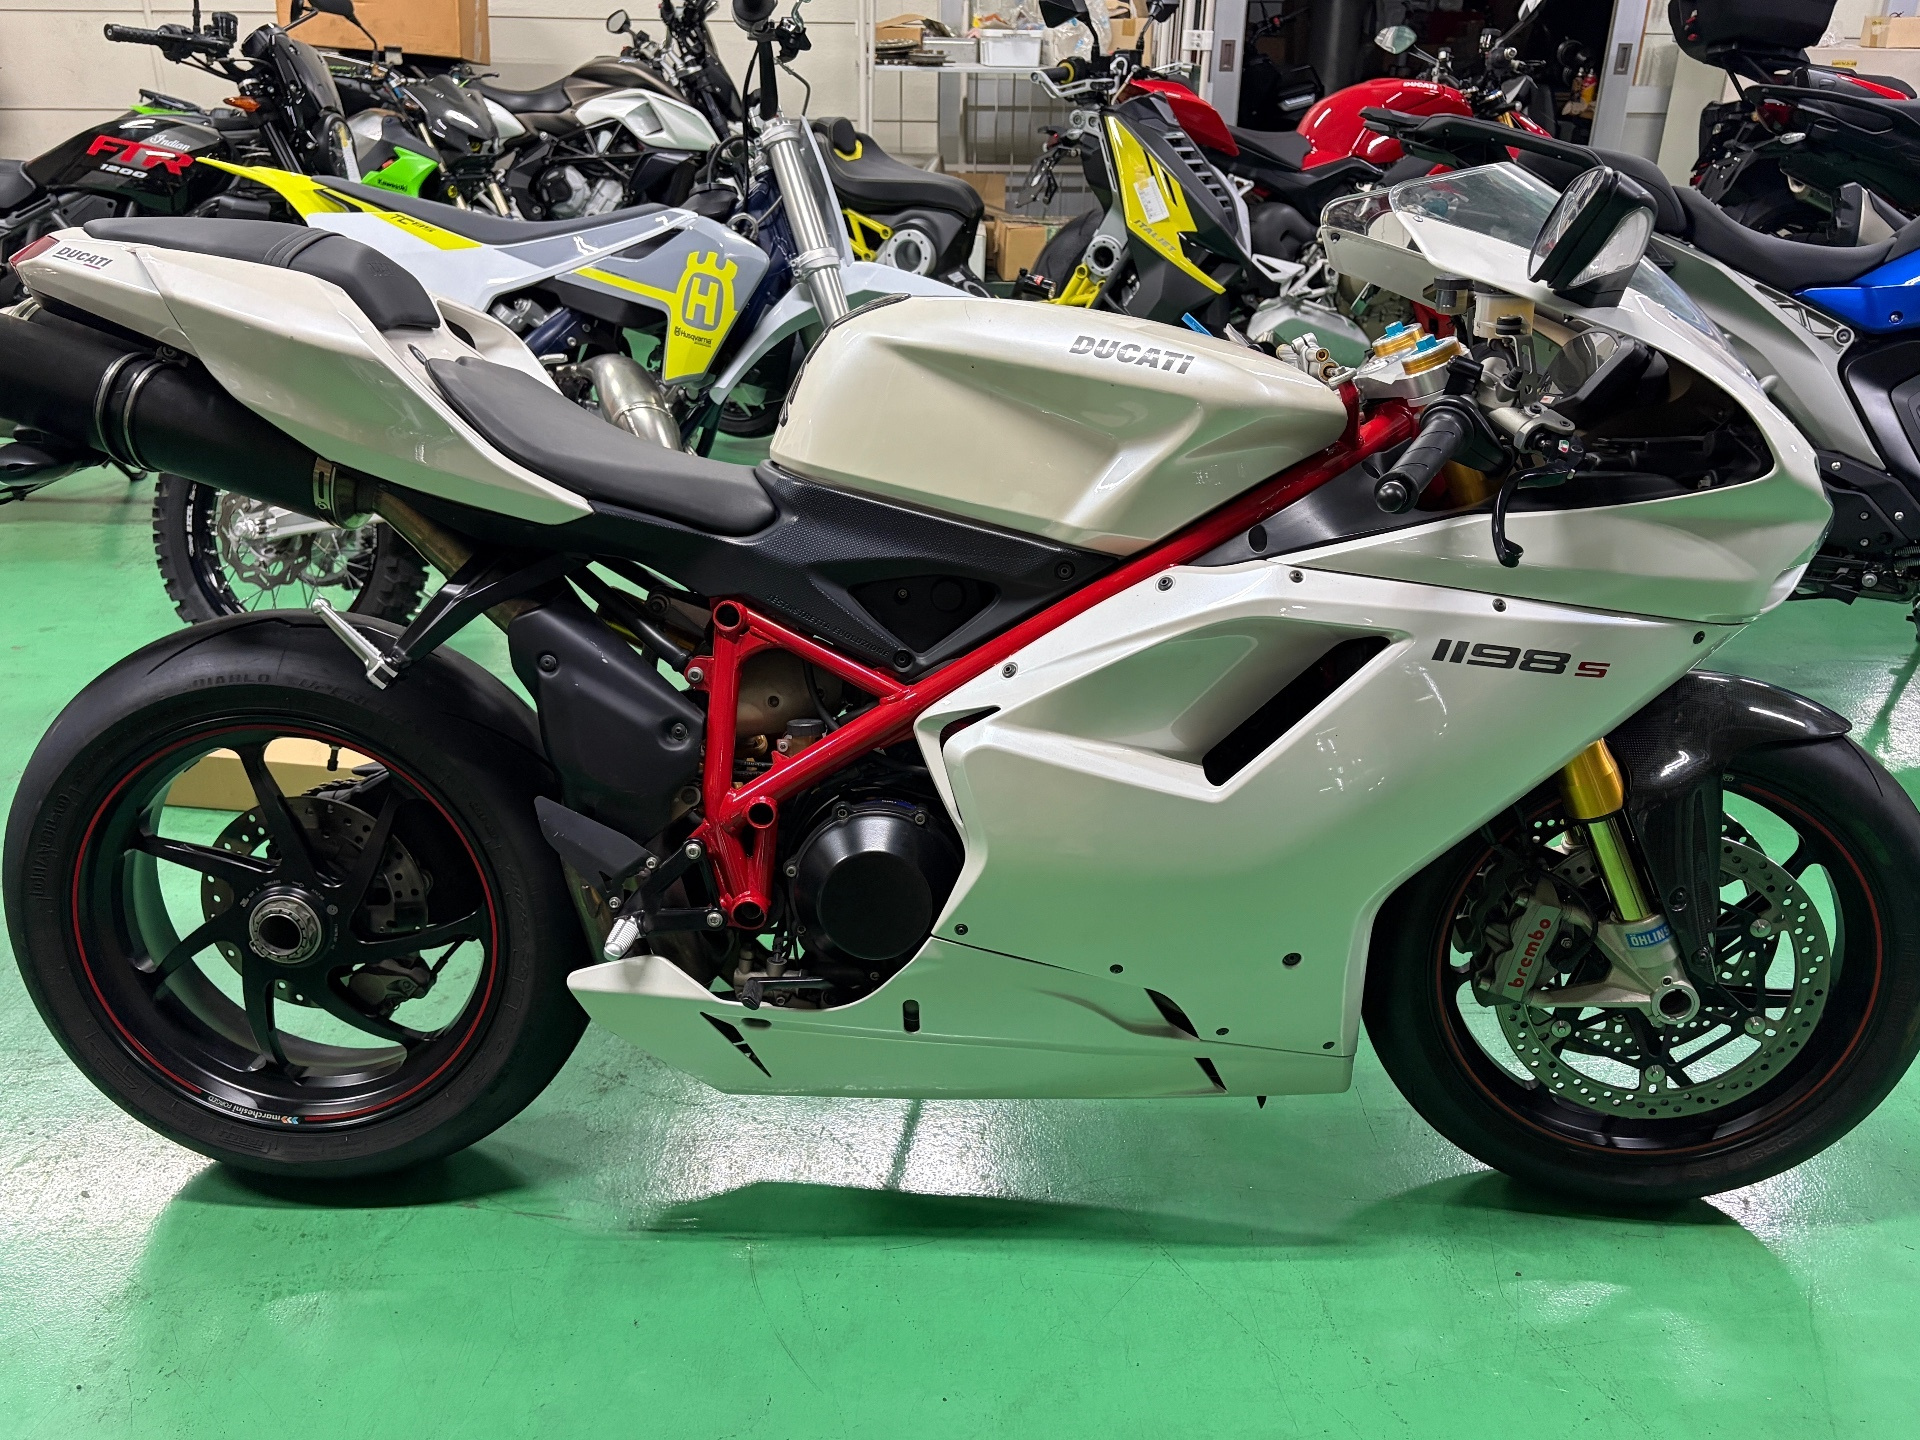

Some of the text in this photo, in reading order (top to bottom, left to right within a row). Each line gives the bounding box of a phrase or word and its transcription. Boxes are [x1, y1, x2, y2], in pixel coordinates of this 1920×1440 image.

[149, 133, 191, 151] Indian
[86, 134, 195, 176] FTR
[100, 163, 148, 179] 1200
[1133, 219, 1177, 252] ITALJET
[55, 246, 114, 267] DUCATI
[680, 330, 712, 346] Husqvarna
[1068, 335, 1195, 375] DUCATI
[832, 627, 890, 658] EVOLUZIONE
[1630, 925, 1670, 947] ÖHLINS
[1508, 918, 1551, 989] brembo
[231, 1105, 281, 1121] marchesini
